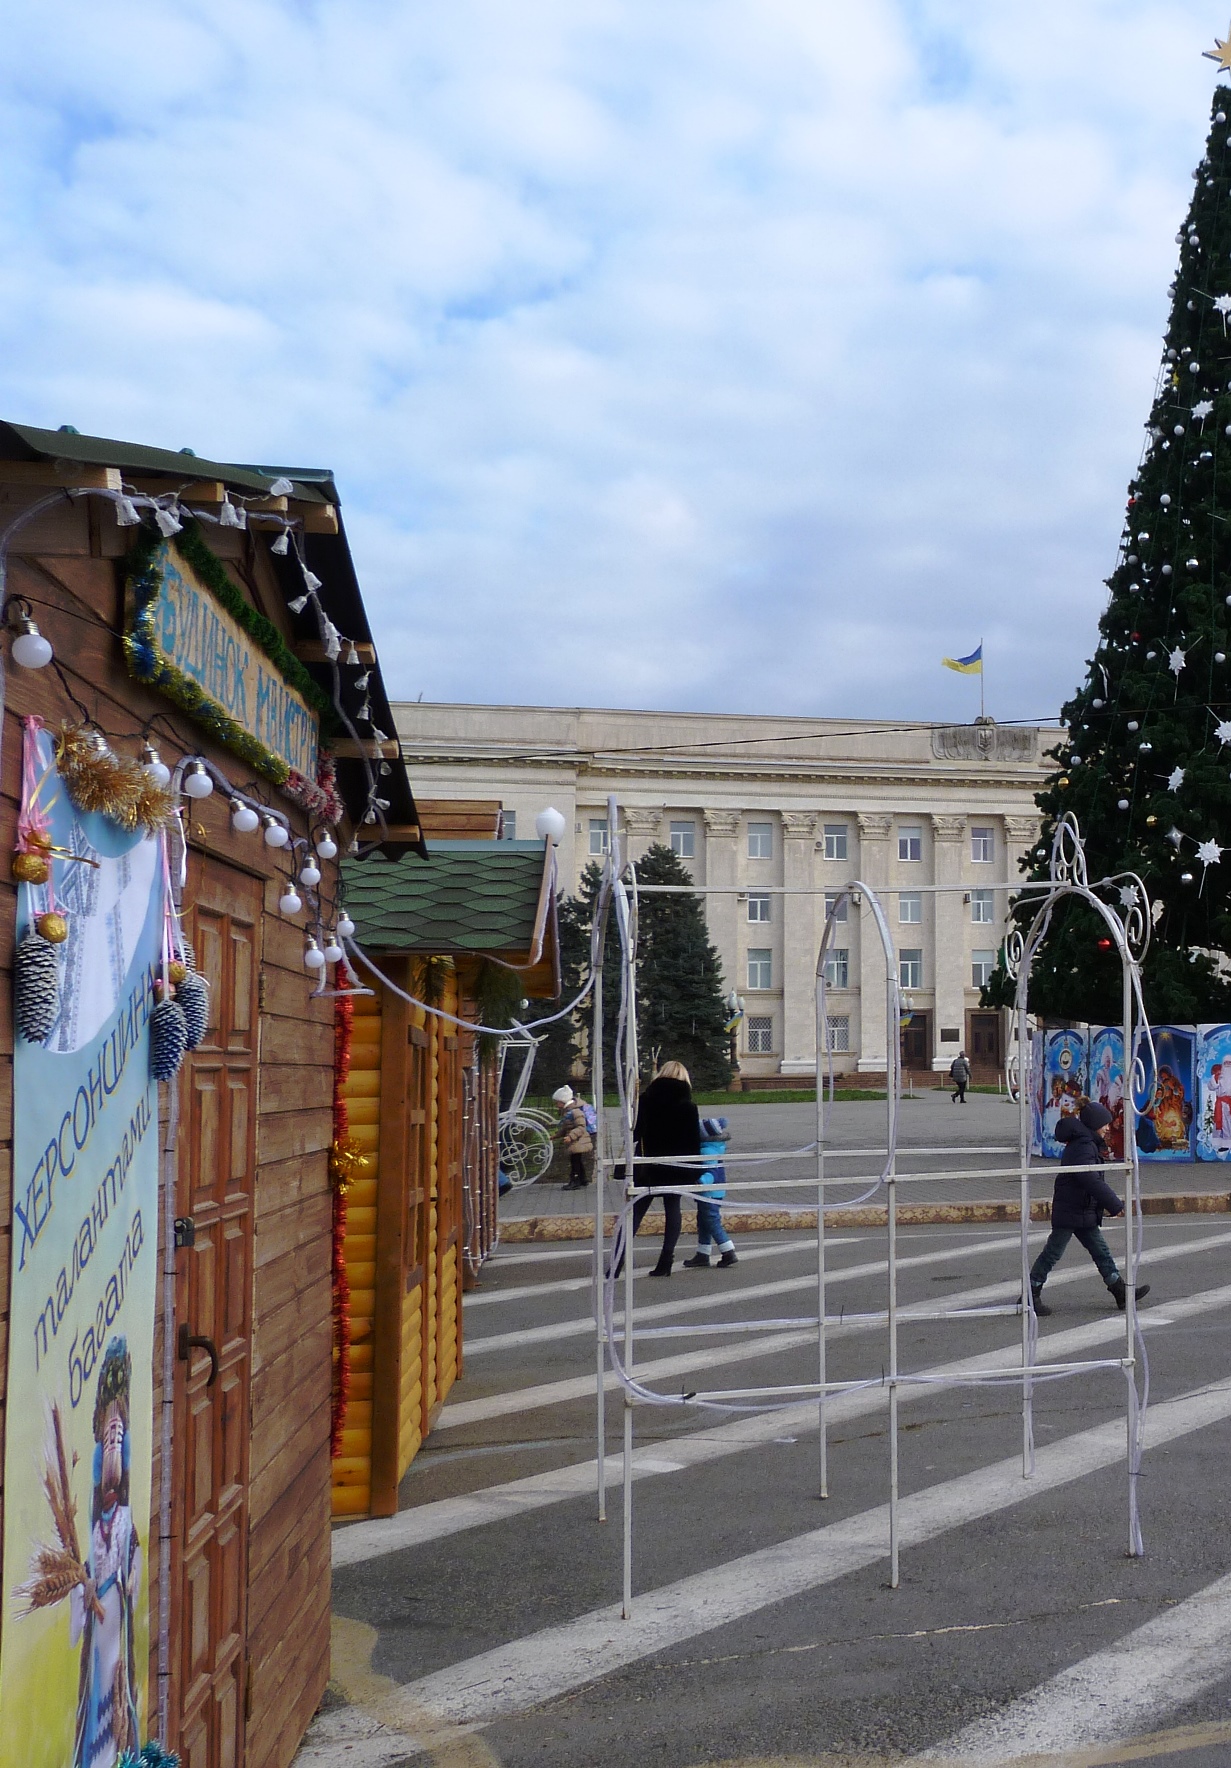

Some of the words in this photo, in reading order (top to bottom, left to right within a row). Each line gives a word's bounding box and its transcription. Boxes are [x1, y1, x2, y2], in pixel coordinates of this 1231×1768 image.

[155, 560, 250, 729] БУДИНОК
[15, 962, 154, 1272] ХЕРСОНЩИНА
[34, 1085, 152, 1373] талантами
[68, 1209, 145, 1410] багата
